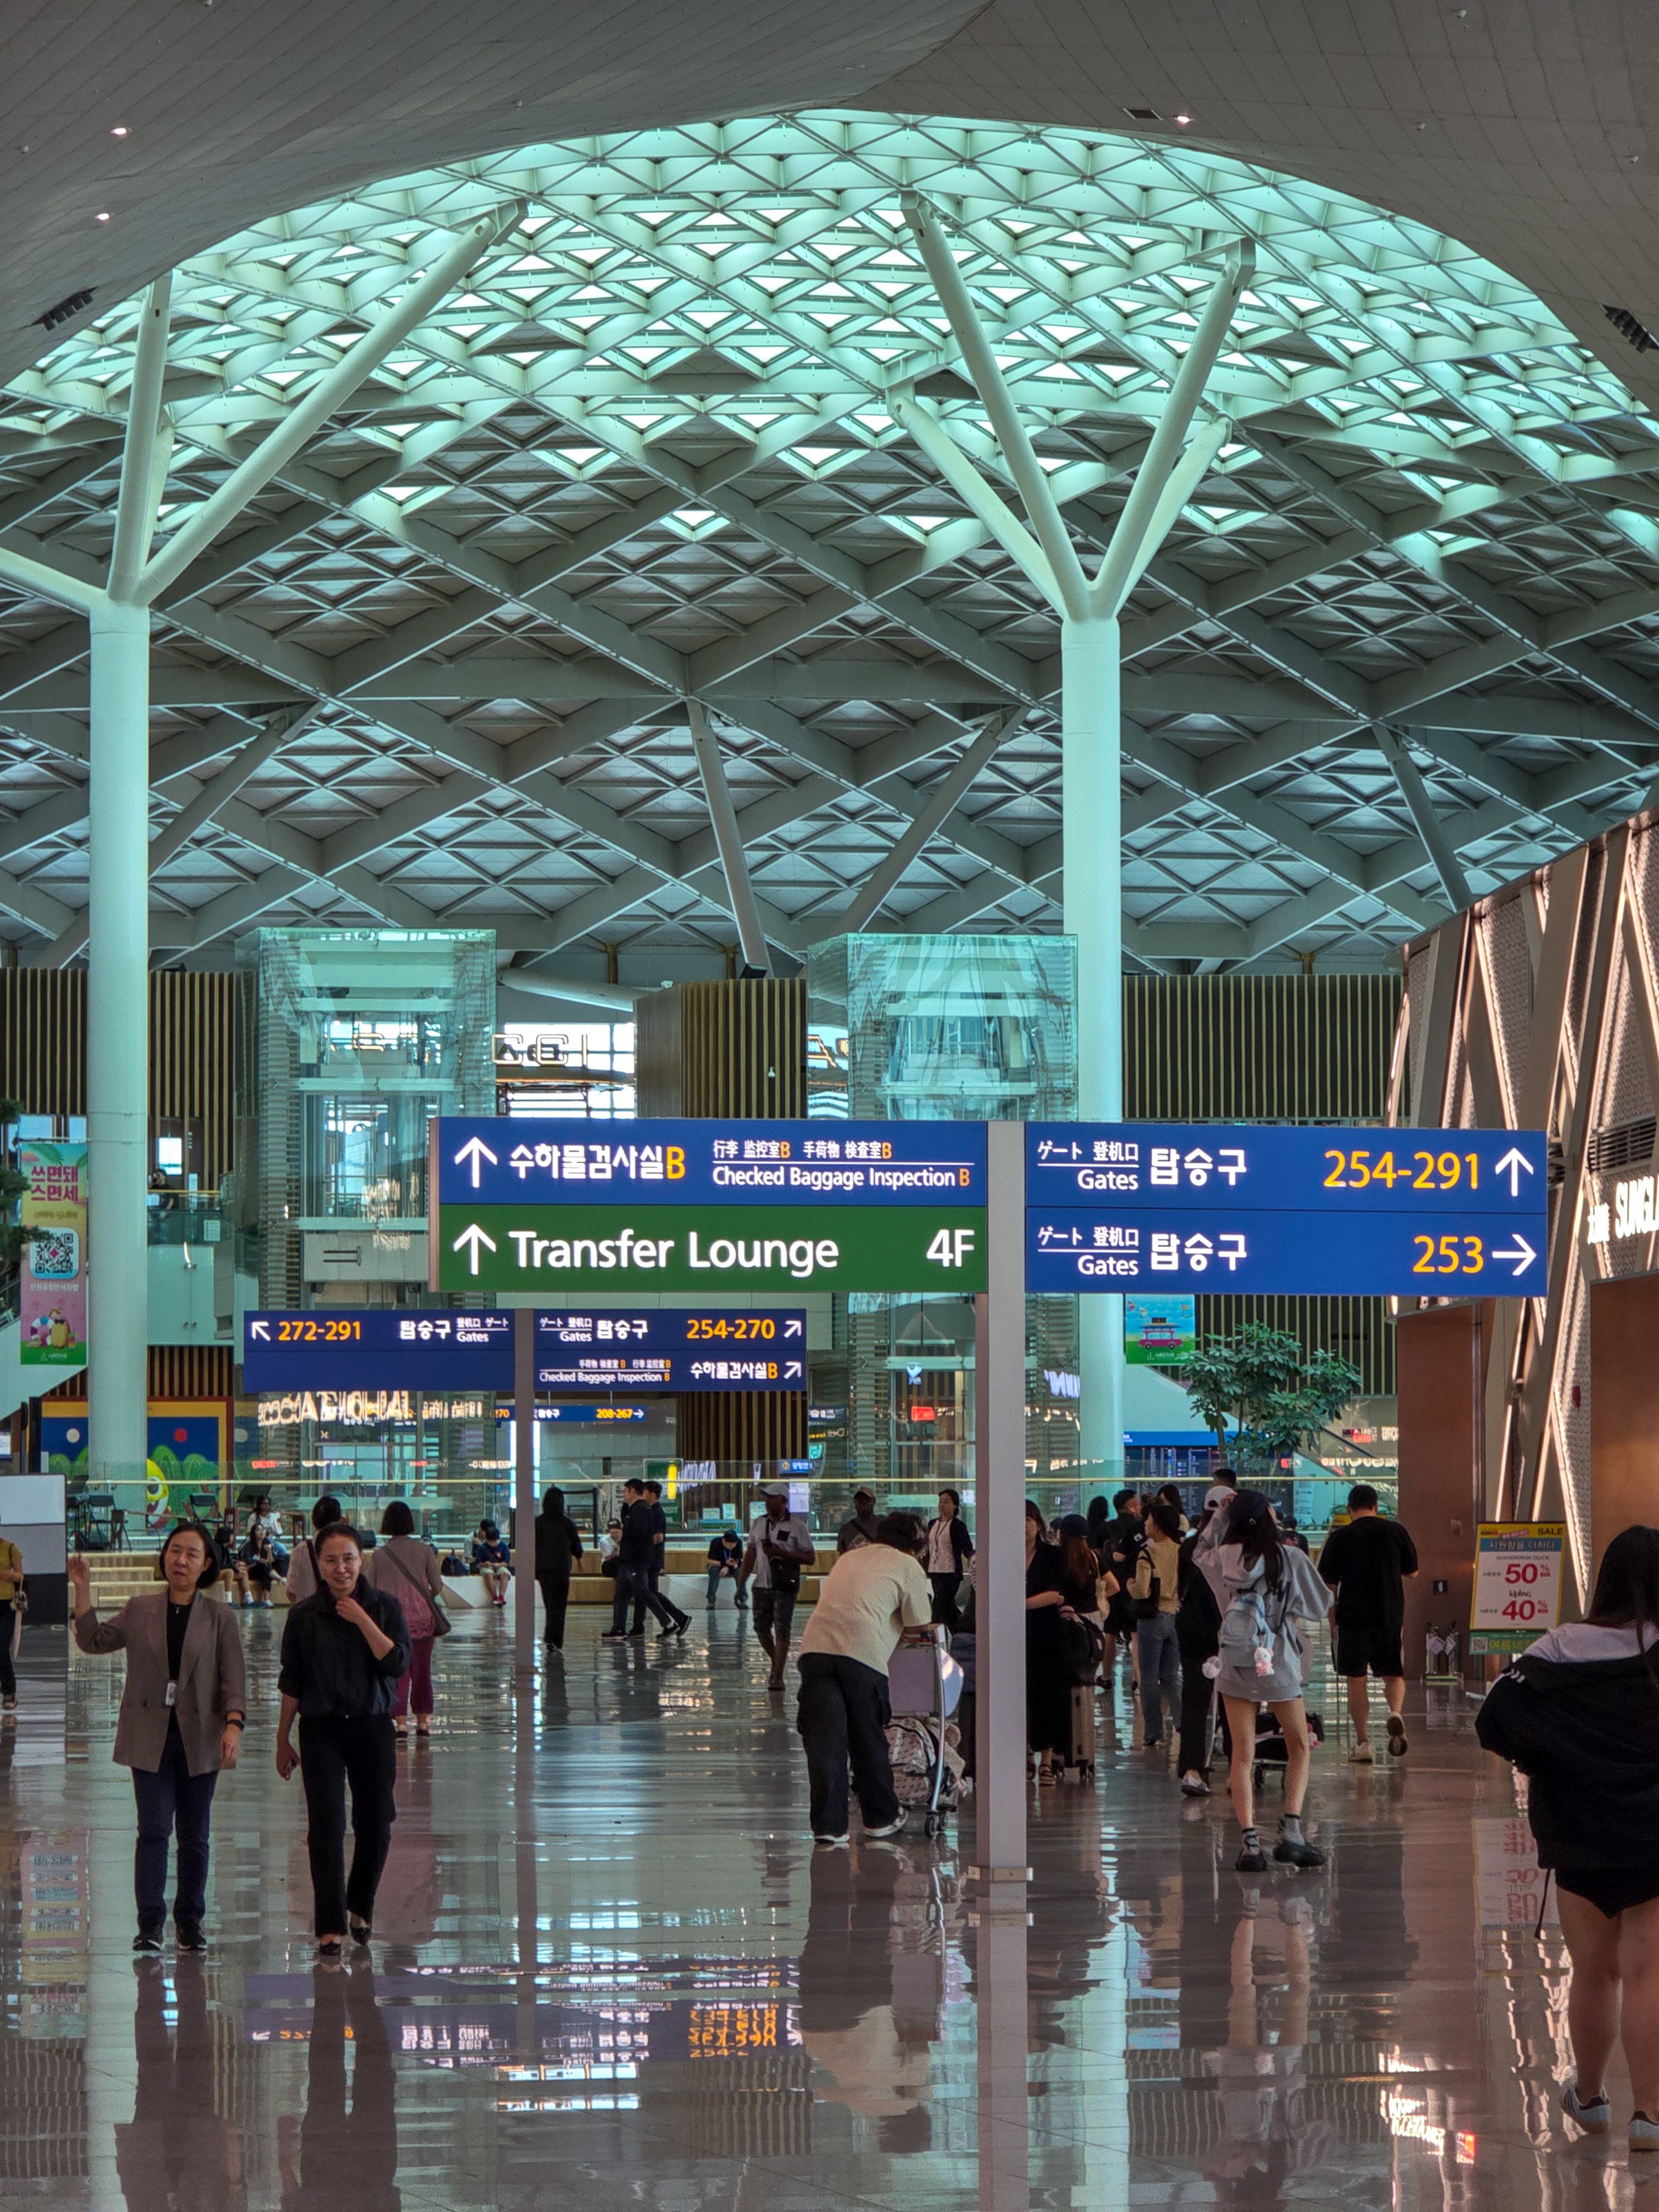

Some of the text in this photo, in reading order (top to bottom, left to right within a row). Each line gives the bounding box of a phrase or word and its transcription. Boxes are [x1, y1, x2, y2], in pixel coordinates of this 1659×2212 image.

[713, 1140, 739, 1158] 行李
[803, 1141, 840, 1158] 手荷物
[1037, 1140, 1083, 1160] ゲート
[1093, 1141, 1138, 1161] 登机口
[31, 1165, 79, 1183] 쓰면돼
[1151, 1148, 1247, 1186] 탑승구
[1323, 1150, 1479, 1189] 254-291
[713, 1166, 970, 1190] Checked Baggage Inspection B
[1078, 1169, 1138, 1190] Gates
[31, 1184, 79, 1201] 스면세
[1615, 1174, 1659, 1238] SUNGL
[1038, 1226, 1083, 1246] ゲート
[1093, 1226, 1138, 1247] 登机口
[508, 1229, 975, 1278] Transfer Lounge 4F
[1151, 1233, 1247, 1271] 탑승구
[1413, 1236, 1484, 1273] 253
[1078, 1255, 1138, 1276] Gates
[278, 1320, 361, 1341] 272-291
[399, 1320, 451, 1340] 탑승구
[456, 1331, 489, 1343] Gates
[560, 1331, 592, 1342] Gates
[597, 1320, 648, 1339] 탑승구
[687, 1319, 775, 1339] 254-270
[539, 1372, 670, 1385] Checked Baggage Inspection B
[1538, 1527, 1563, 1536] SALE
